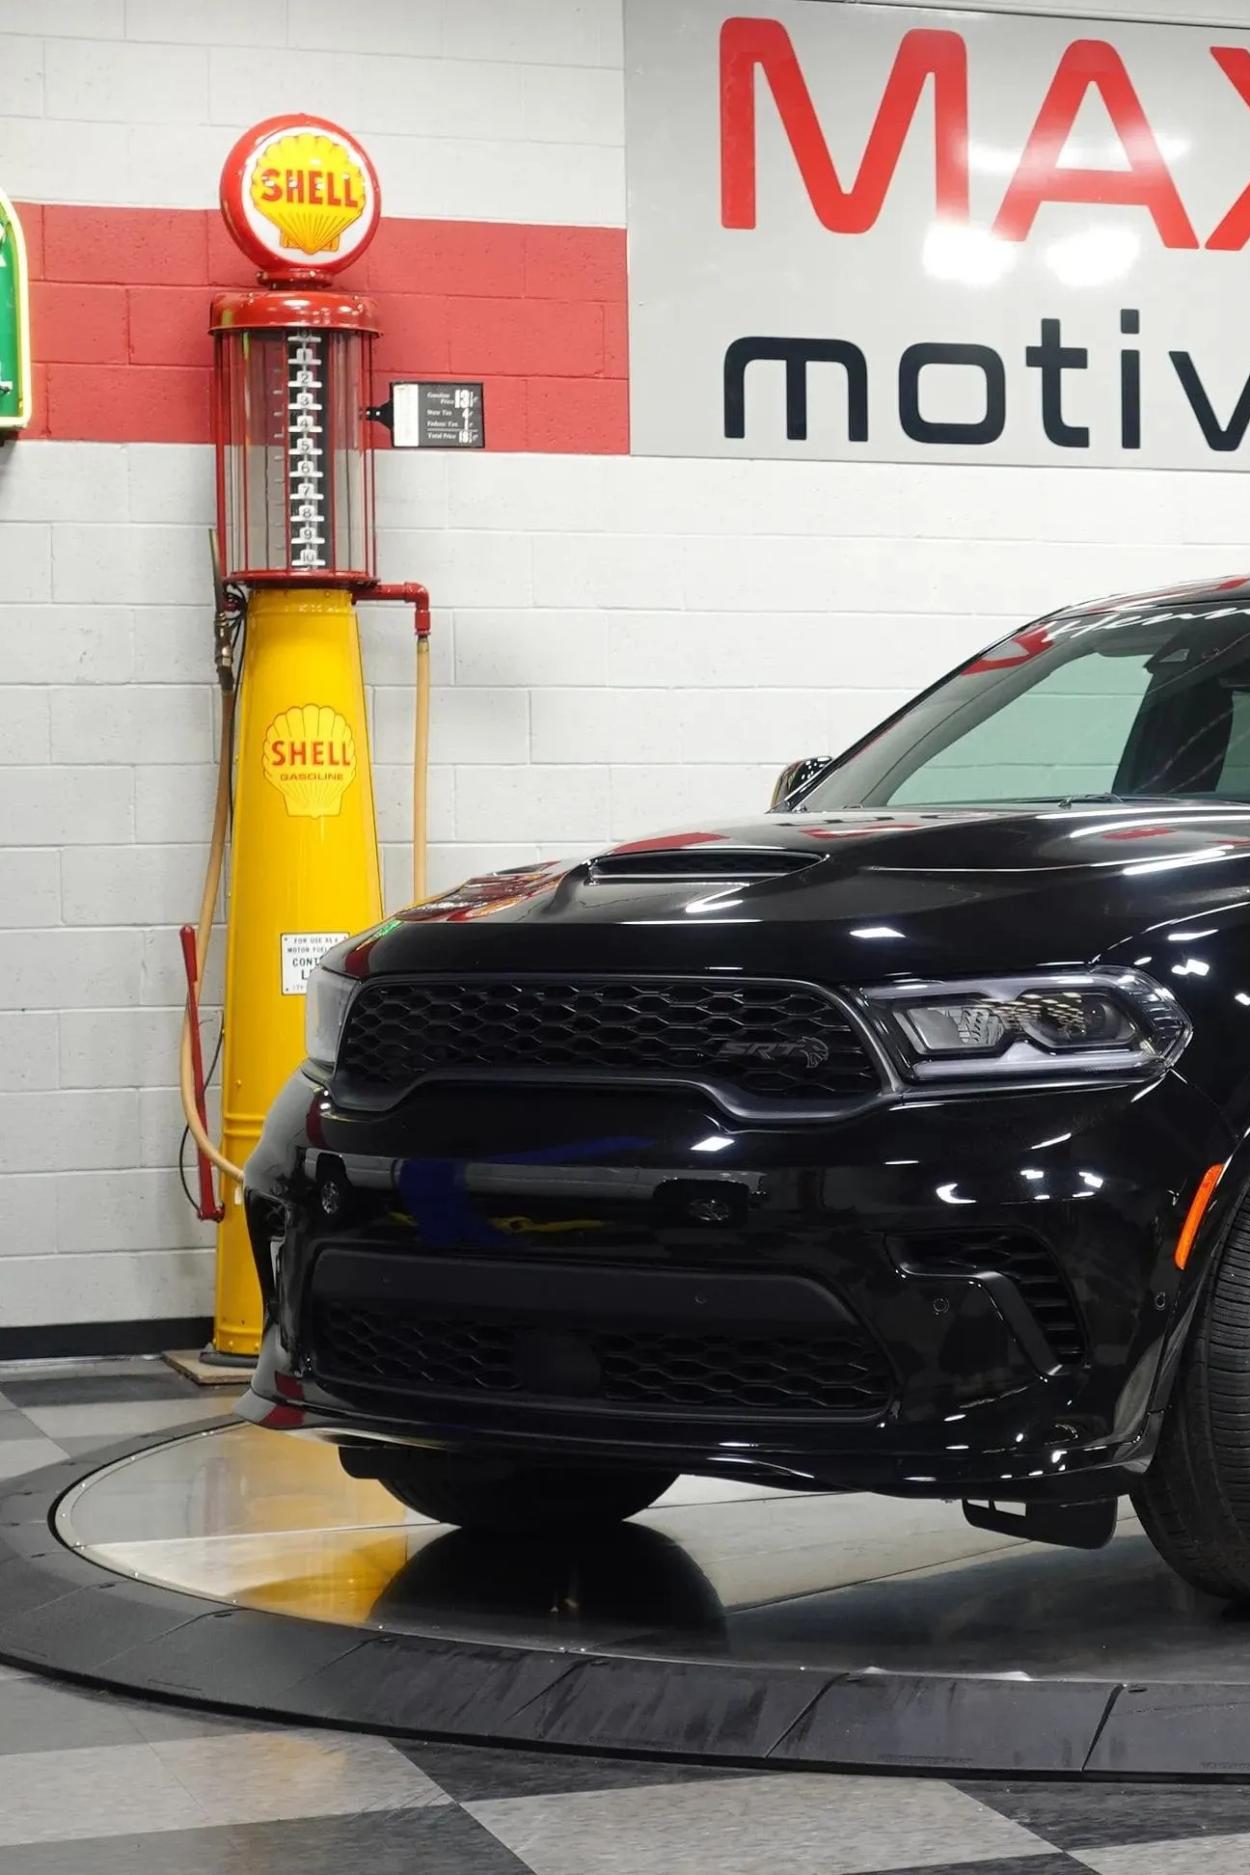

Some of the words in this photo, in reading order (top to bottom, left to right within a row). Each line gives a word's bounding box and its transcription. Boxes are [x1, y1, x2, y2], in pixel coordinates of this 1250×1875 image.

[261, 168, 359, 208] SHELL
[271, 740, 351, 767] SHELL
[280, 773, 343, 781] GASOLINE
[717, 1042, 806, 1060] SRT
